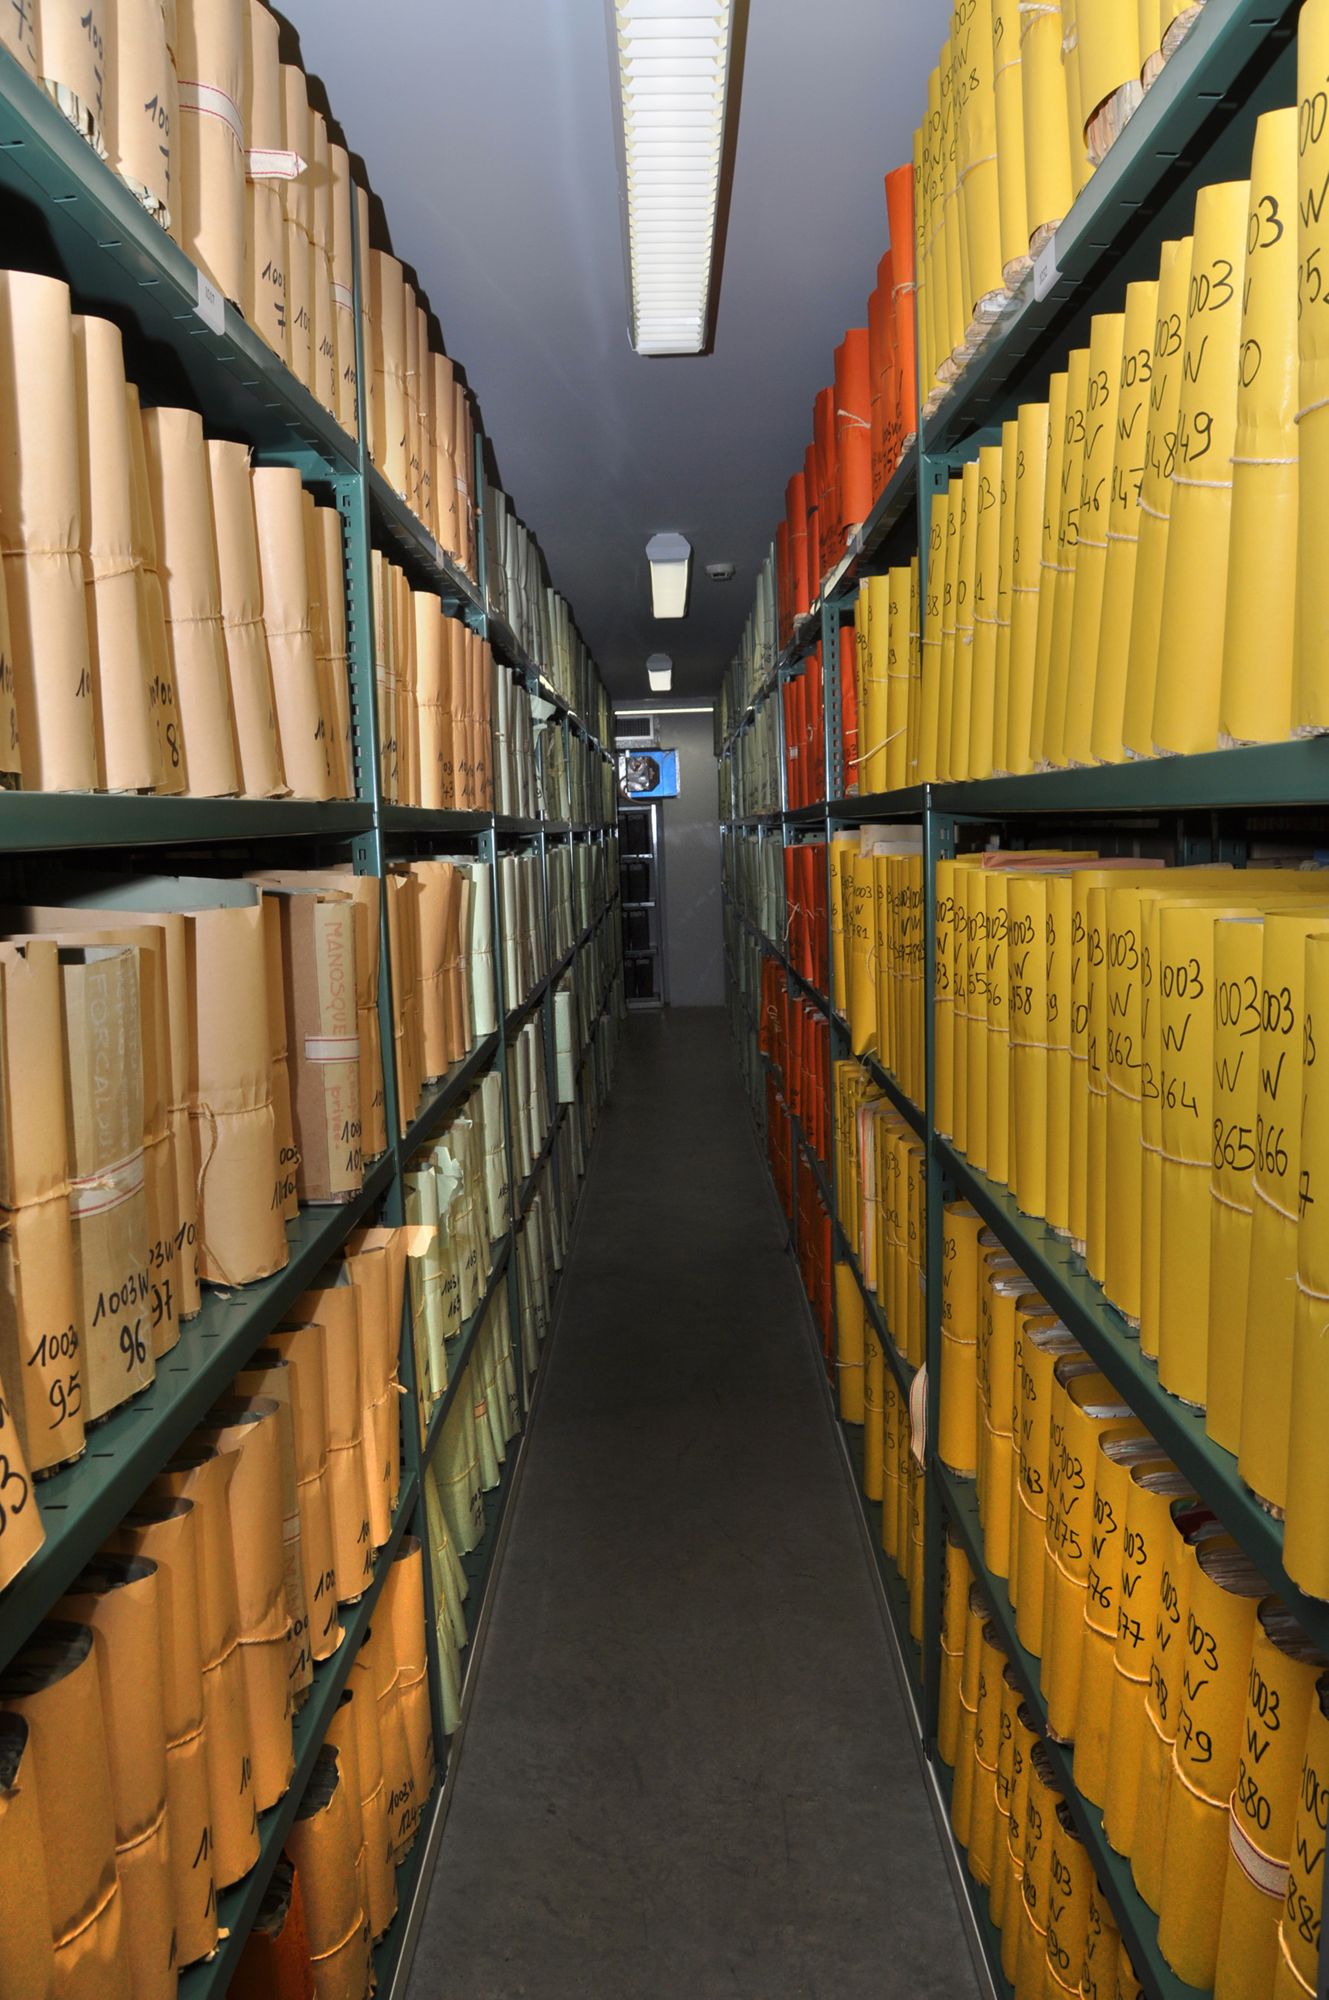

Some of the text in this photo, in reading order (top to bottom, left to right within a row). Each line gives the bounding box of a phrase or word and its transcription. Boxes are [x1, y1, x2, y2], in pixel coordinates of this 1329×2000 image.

[1184, 335, 1208, 383] W
[325, 921, 347, 1036] MANOSQUE
[1109, 983, 1132, 1017] W
[1160, 958, 1204, 999] 1003
[1214, 976, 1262, 1036] 1003
[1162, 1013, 1192, 1051] W
[1215, 1051, 1244, 1092] W
[1261, 1051, 1286, 1101] W
[1213, 1118, 1256, 1171] 865
[1257, 1114, 1288, 1177] 866
[120, 1319, 146, 1373] 96
[1122, 1567, 1141, 1598] W
[1249, 1657, 1280, 1731] 1003
[1248, 1717, 1270, 1764] W
[1240, 1758, 1271, 1831] 880
